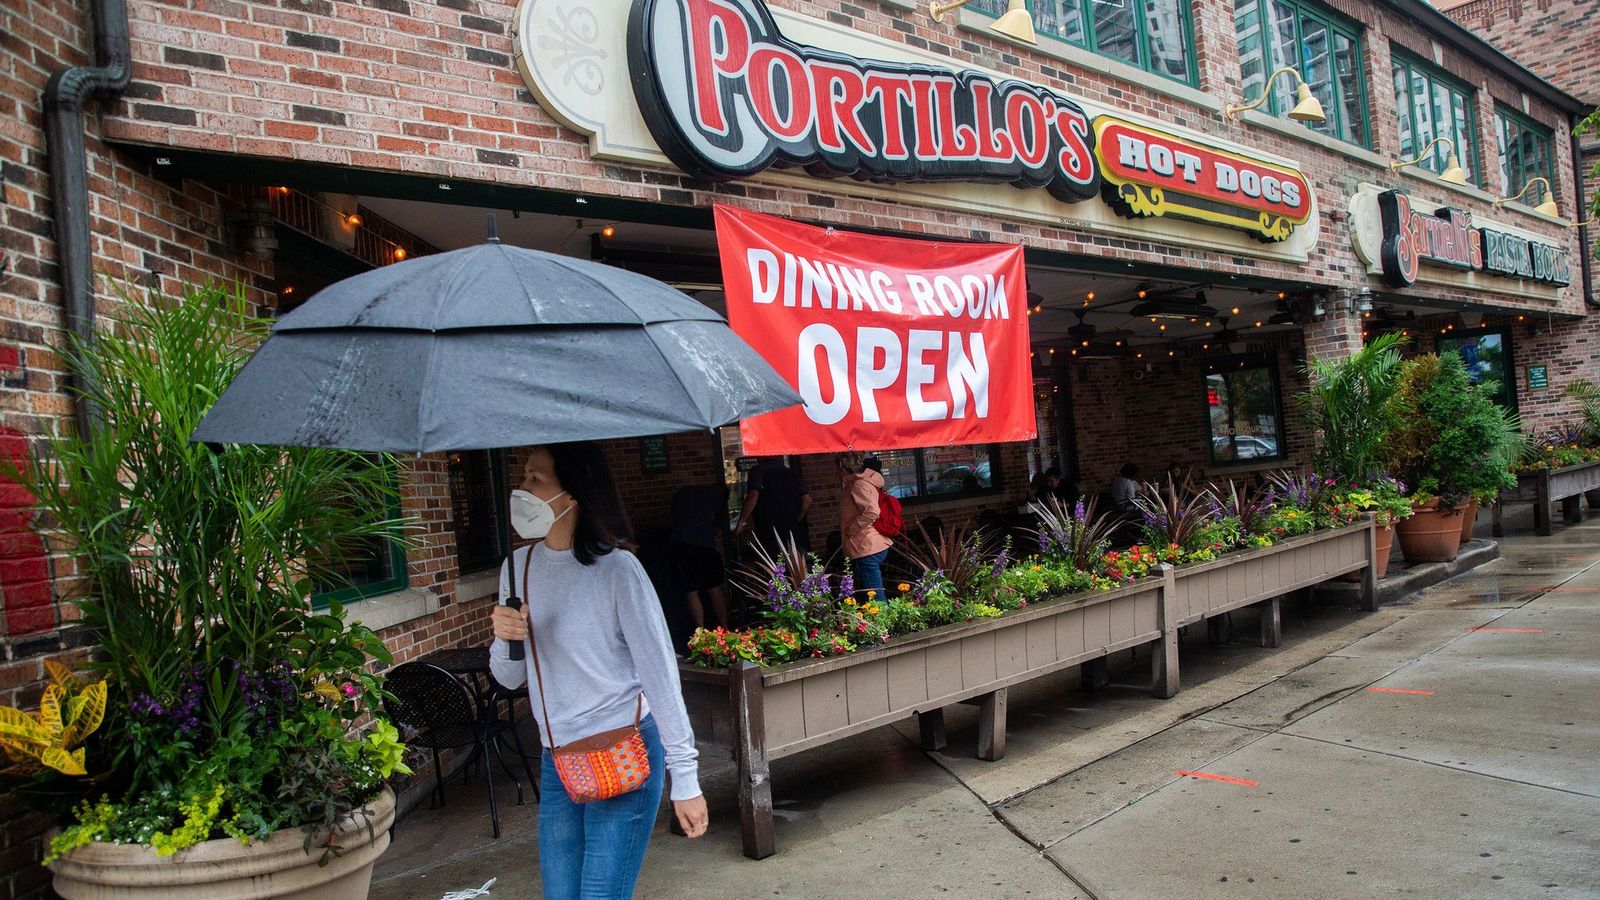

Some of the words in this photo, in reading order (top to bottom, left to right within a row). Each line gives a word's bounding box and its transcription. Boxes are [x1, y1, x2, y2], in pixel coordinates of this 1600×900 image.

[686, 0, 1094, 184] PORTILLO'S
[1117, 133, 1202, 184] HOT
[1214, 162, 1302, 208] DOGS
[746, 247, 903, 315] DINING
[905, 273, 1010, 320] ROOM
[1485, 229, 1534, 278] PASTA
[797, 323, 990, 425] OPEN
